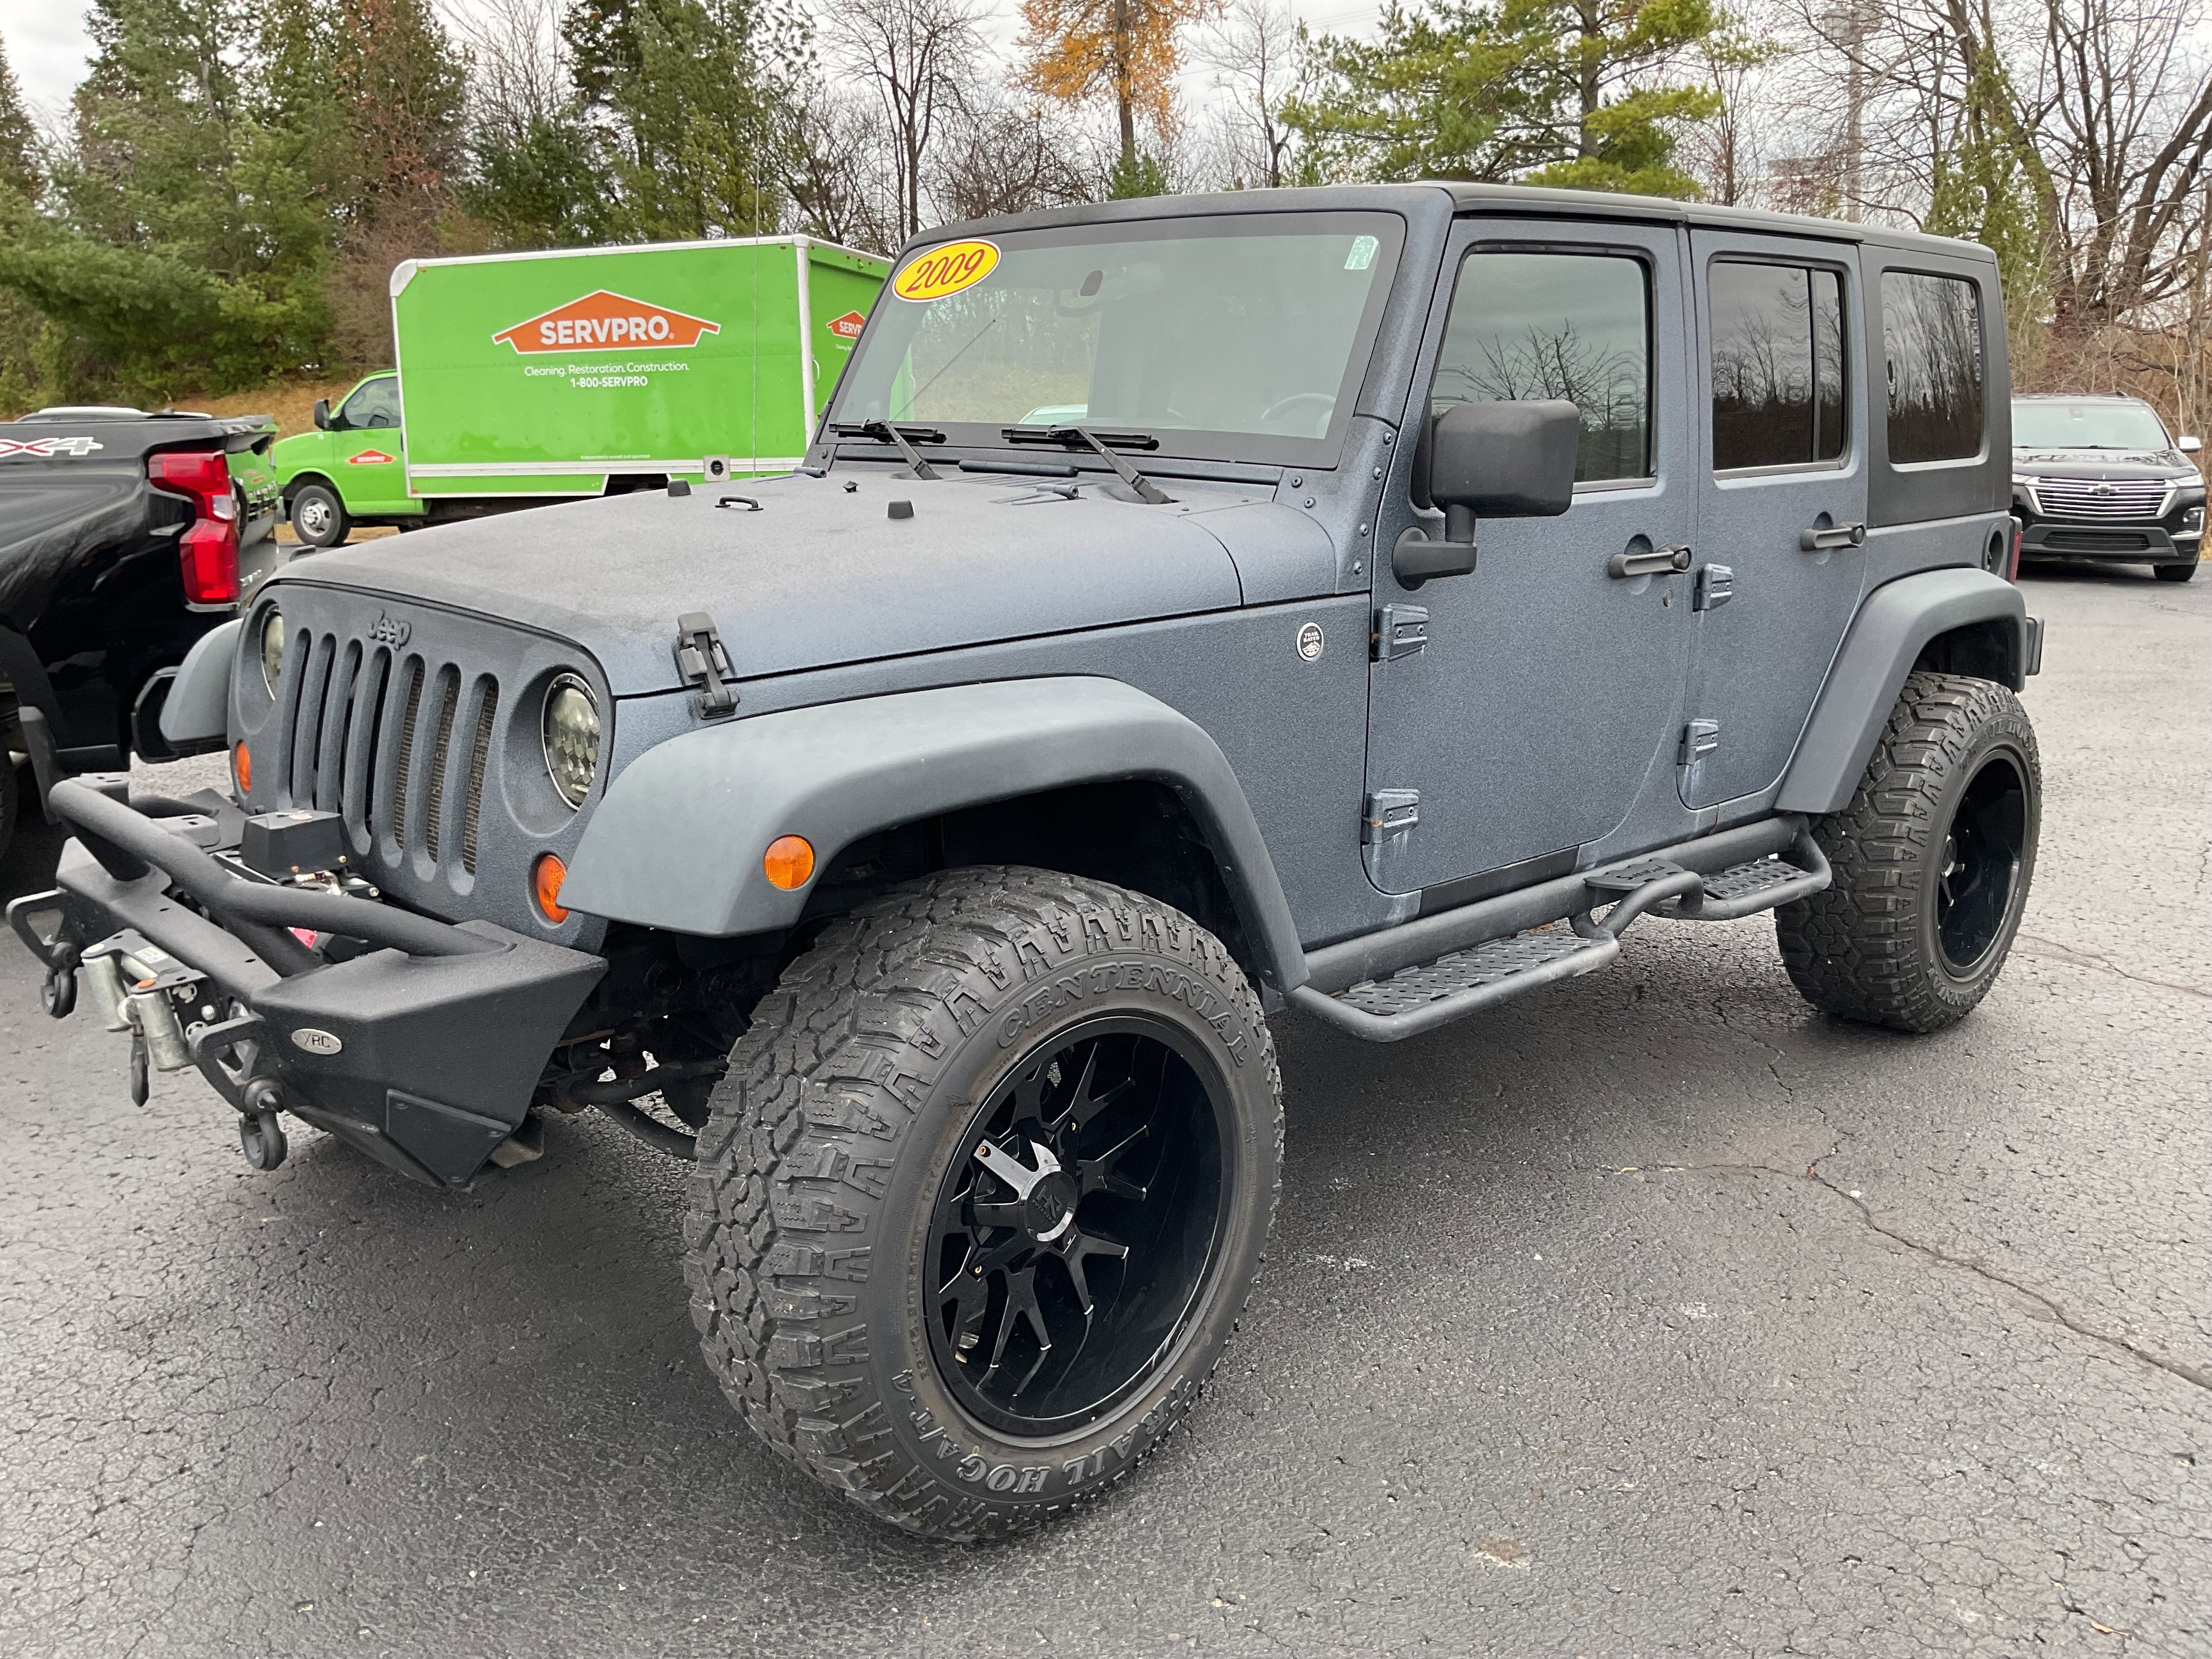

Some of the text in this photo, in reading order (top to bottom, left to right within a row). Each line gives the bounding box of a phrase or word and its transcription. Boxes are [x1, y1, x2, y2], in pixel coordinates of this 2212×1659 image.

[905, 249, 985, 293] 2009
[540, 315, 669, 345] SERVPRO
[524, 362, 690, 377] Cleaning. Restoration. Construction.
[571, 376, 648, 388] 1-800-SERVPRO
[997, 961, 1249, 1067] CENTENNIAL
[302, 1032, 330, 1048] XRC
[1063, 1374, 1192, 1486] TRAIL
[956, 1454, 1051, 1493] HOG
